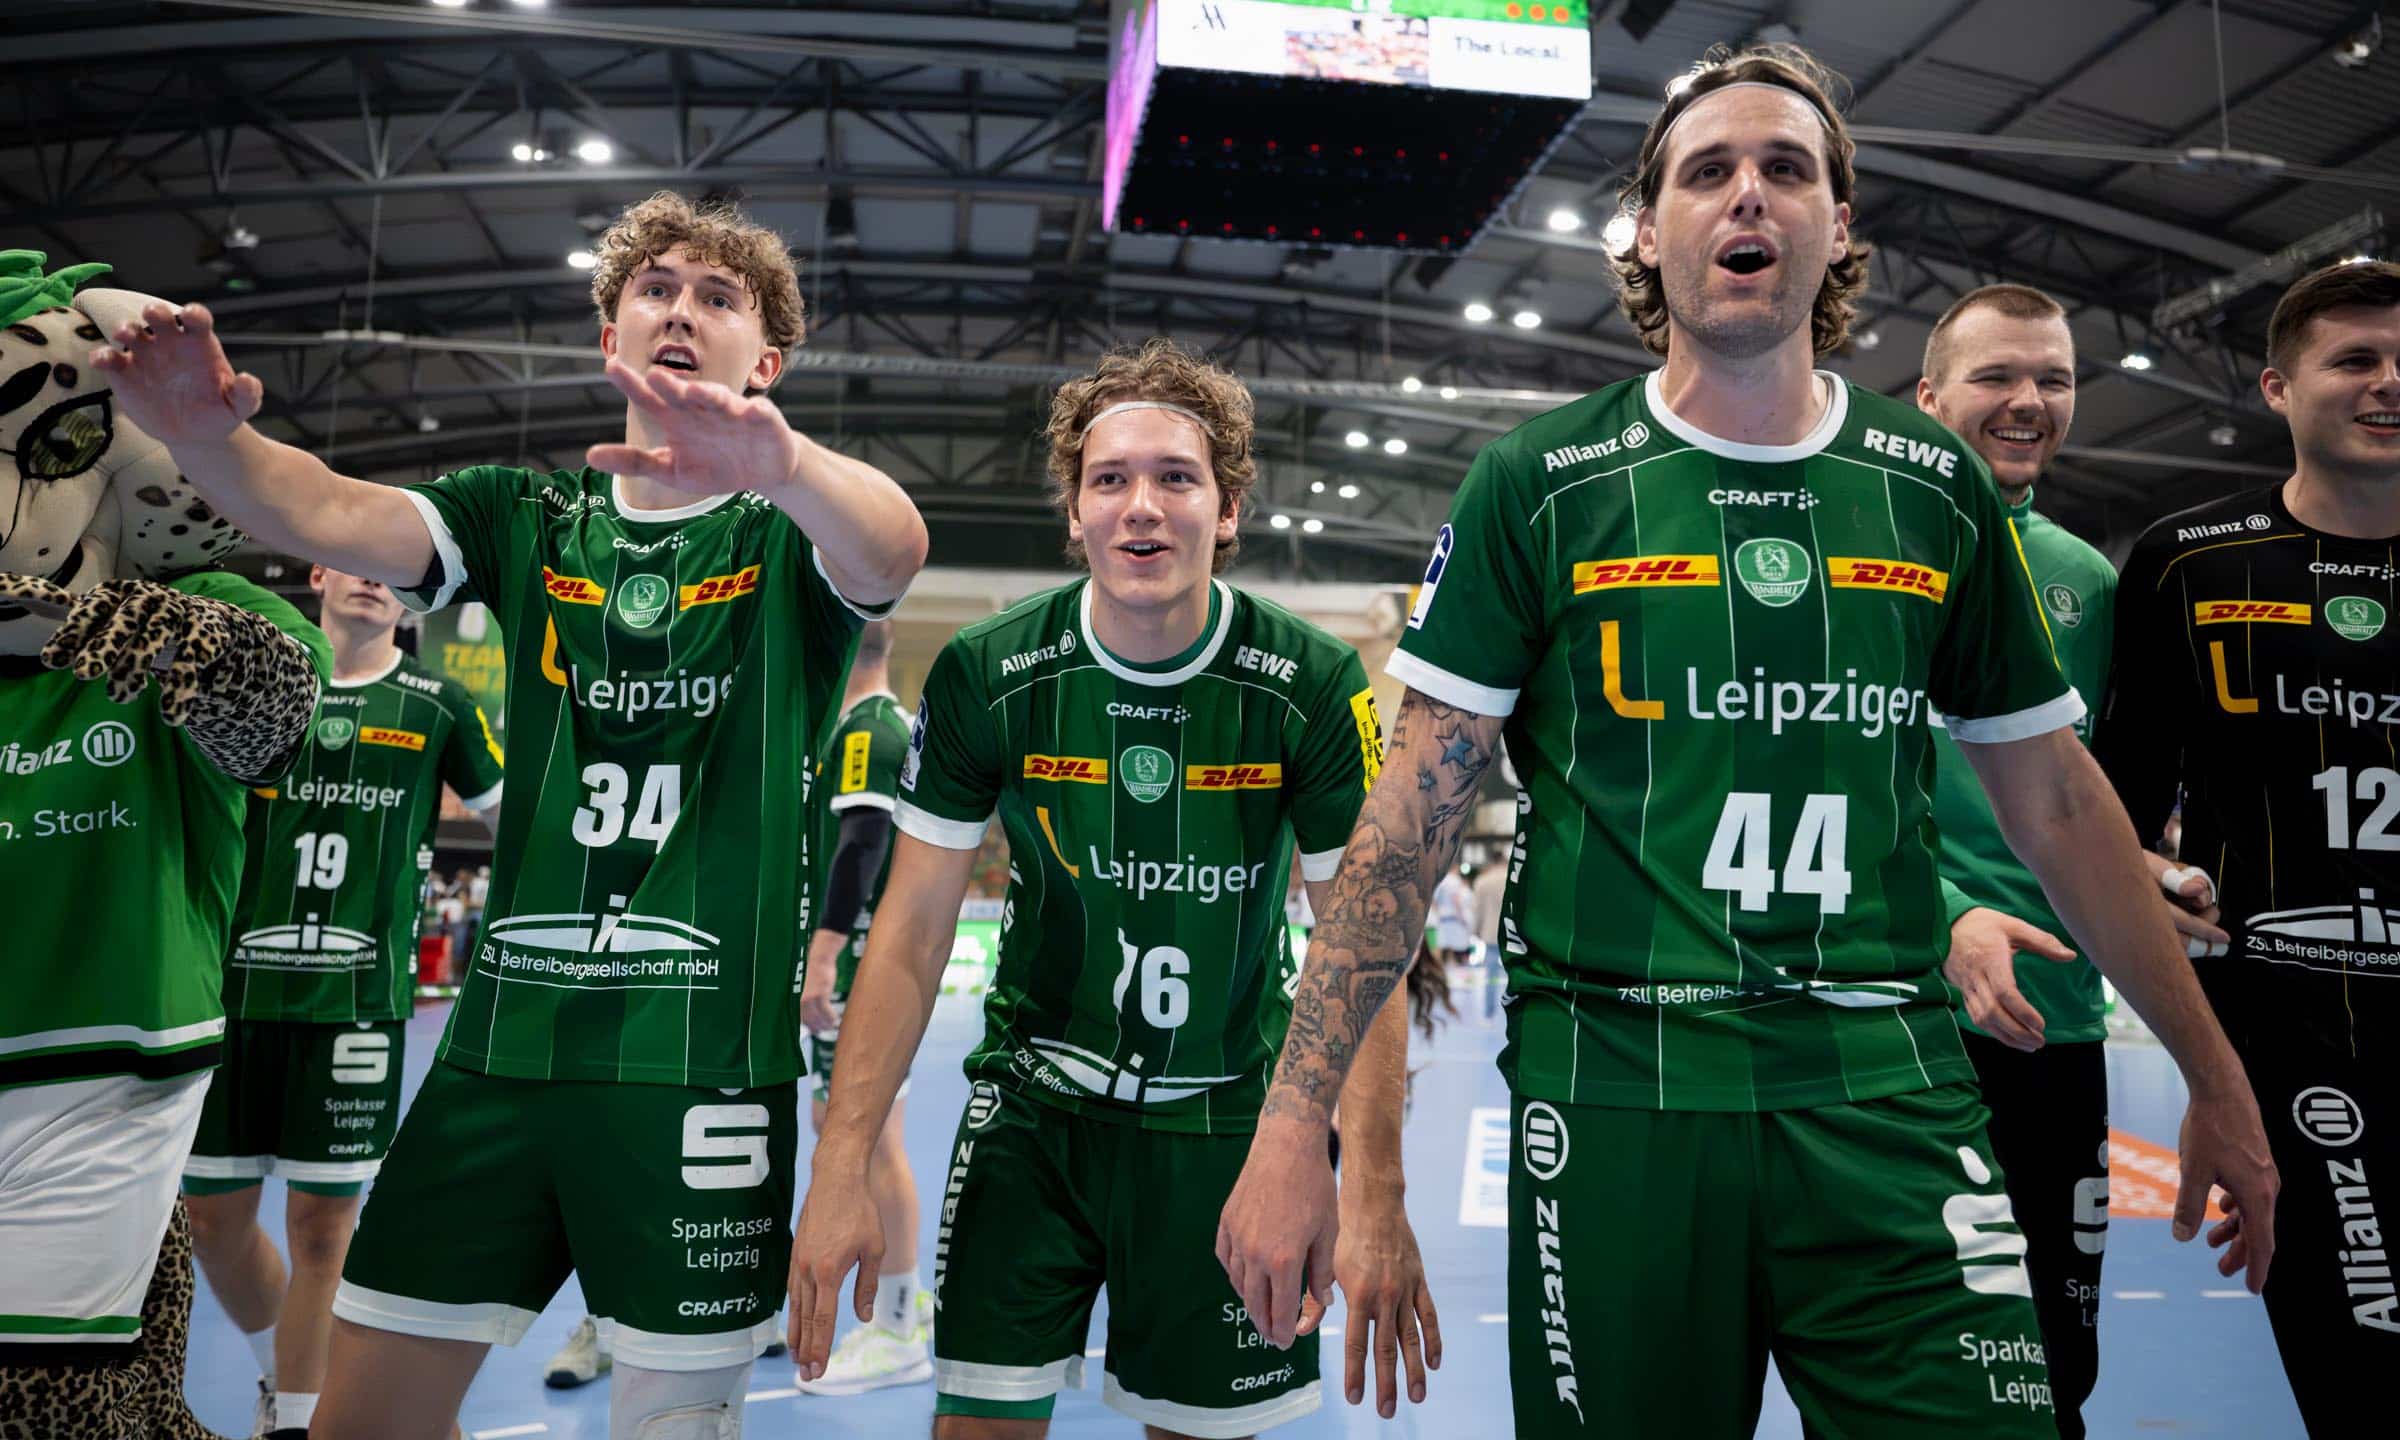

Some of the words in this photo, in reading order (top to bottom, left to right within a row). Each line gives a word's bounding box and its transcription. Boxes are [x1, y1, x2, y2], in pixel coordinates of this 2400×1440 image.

[1544, 439, 1621, 473] Allianz
[1864, 427, 1959, 479] REWE
[1707, 488, 1795, 506] CRAFT
[2176, 521, 2245, 543] Allianz
[694, 568, 757, 600] DHL
[1593, 560, 1702, 586] DHL
[1849, 563, 1937, 596] DHL
[2307, 561, 2382, 578] CRAFT
[2208, 603, 2296, 620] DHL
[1001, 645, 1058, 676] Allianz
[1234, 645, 1299, 684] REWE
[397, 671, 443, 694] REWE
[571, 664, 741, 722] Leipzige
[320, 694, 357, 706] RAFT
[1106, 702, 1173, 721] CRAFT
[1686, 666, 1924, 738] Leipziger
[2276, 673, 2400, 728] Leipz
[372, 730, 418, 745] DHL
[1028, 757, 1097, 779] DHL
[1199, 767, 1268, 788] DHL
[286, 775, 406, 812] Leipziger
[572, 762, 681, 855] 34
[2312, 765, 2400, 852] 12
[34, 800, 137, 837] Stark.
[294, 832, 350, 890] 19
[1702, 791, 1852, 915] 44
[1089, 845, 1265, 904] Leipziger
[480, 943, 497, 965] ZSL
[499, 950, 674, 981] Betreibergesellschaft
[678, 958, 719, 977] mbH
[2245, 935, 2272, 951] ZSL
[2274, 938, 2400, 968] Betreibergese
[1015, 1047, 1037, 1071] ZSL
[324, 1098, 387, 1113] Sparkasse
[334, 1115, 376, 1130] Leipzig
[328, 1142, 366, 1155] CRAFT
[671, 1216, 773, 1243] Sparkasse
[934, 1140, 975, 1313] Allianz
[686, 1245, 760, 1273] Leipzig
[2326, 1158, 2400, 1334] Allianz
[678, 1297, 746, 1317] CRAFT
[1535, 1195, 1585, 1426] Allianz
[1959, 1332, 2047, 1369] Sparkas
[1231, 1368, 1285, 1391] CRAFT
[1988, 1373, 2056, 1415] Leipzi
